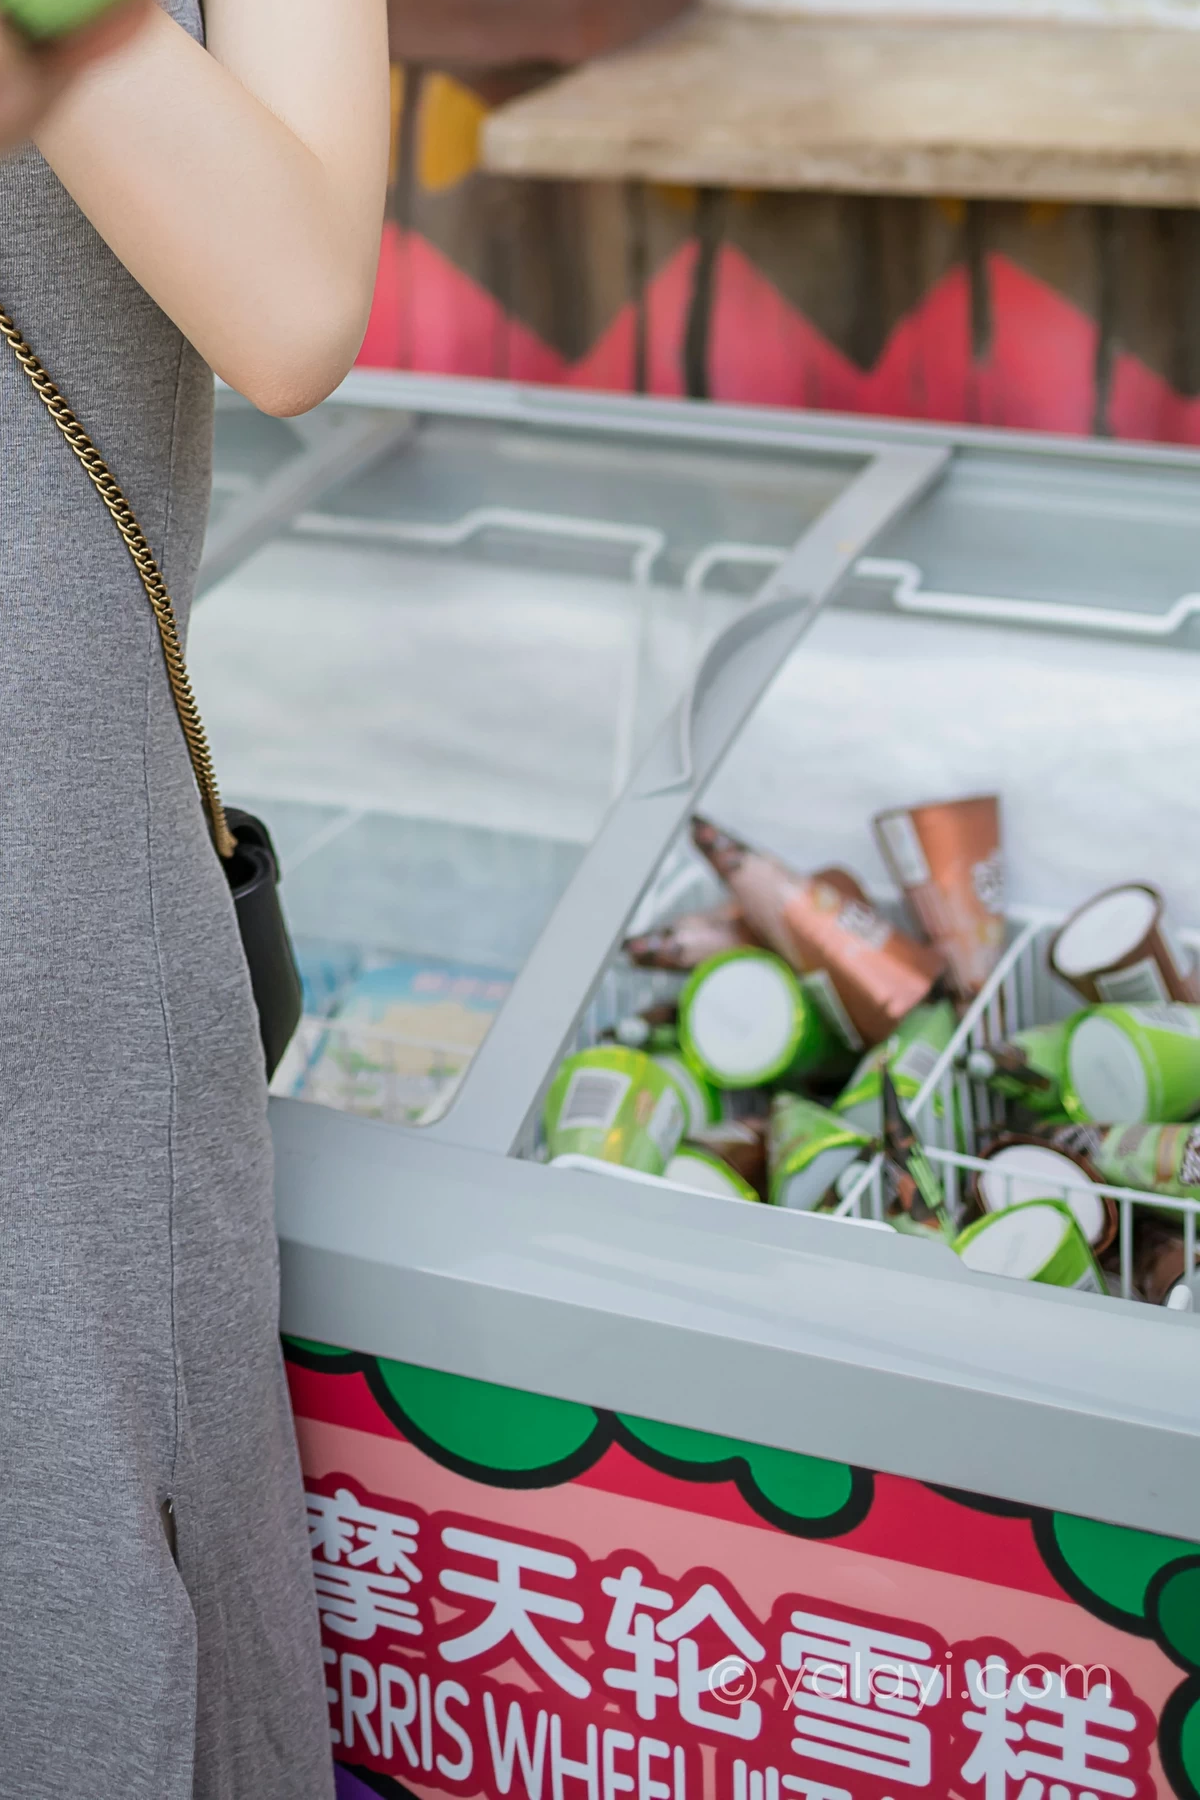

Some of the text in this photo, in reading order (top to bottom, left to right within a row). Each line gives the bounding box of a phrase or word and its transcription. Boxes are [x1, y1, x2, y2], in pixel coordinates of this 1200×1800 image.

[306, 1487, 1138, 1800] 摩天轮雪糕
